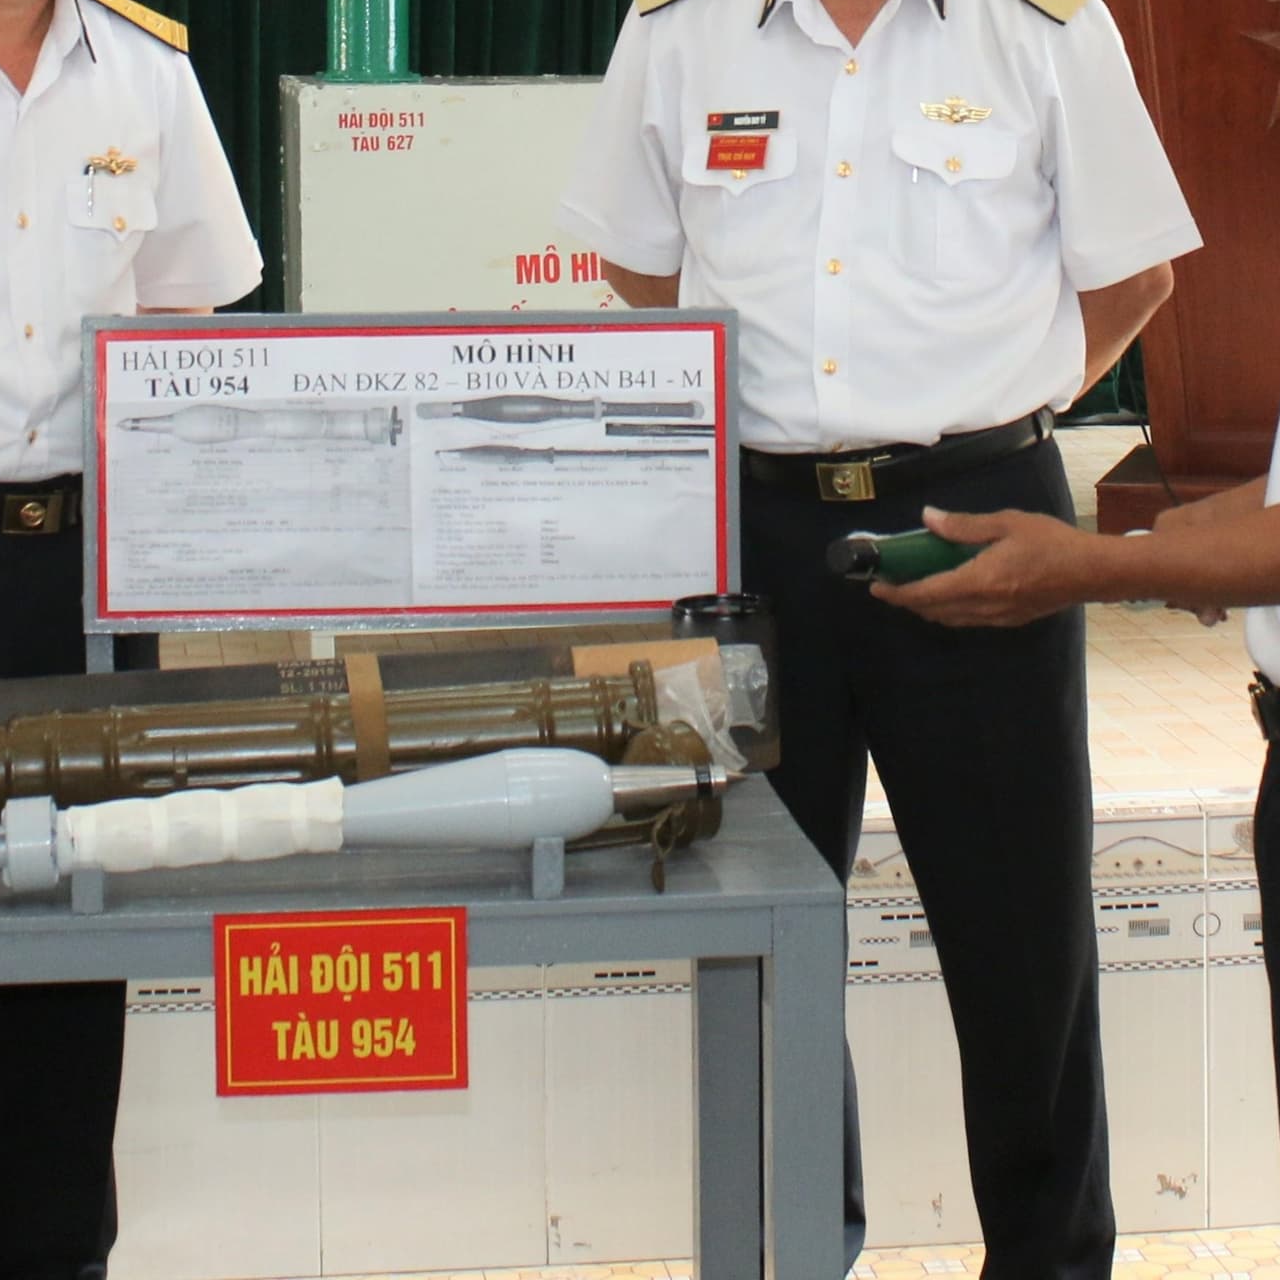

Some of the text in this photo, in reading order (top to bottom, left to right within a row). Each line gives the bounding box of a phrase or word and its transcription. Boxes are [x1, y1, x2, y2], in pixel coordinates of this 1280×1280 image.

[338, 106, 425, 131] HẢI ĐỘI 511
[352, 130, 414, 152] TÀU 627
[516, 244, 561, 285] MÔ
[122, 344, 270, 373] HẢI ĐỘI 511
[451, 337, 575, 365] MÔ HÌNH
[145, 371, 251, 398] TÀU 954
[293, 372, 347, 396] ĐẠN
[355, 372, 408, 392] ĐKZ
[414, 371, 440, 391] 82
[466, 371, 509, 391] B10
[516, 365, 549, 390] VÀ
[557, 370, 611, 394] ĐẠN
[618, 369, 657, 389] B41
[681, 369, 704, 388] M
[240, 943, 442, 1001] HẢI ĐỘI 511
[272, 1013, 416, 1060] TÀU 954
